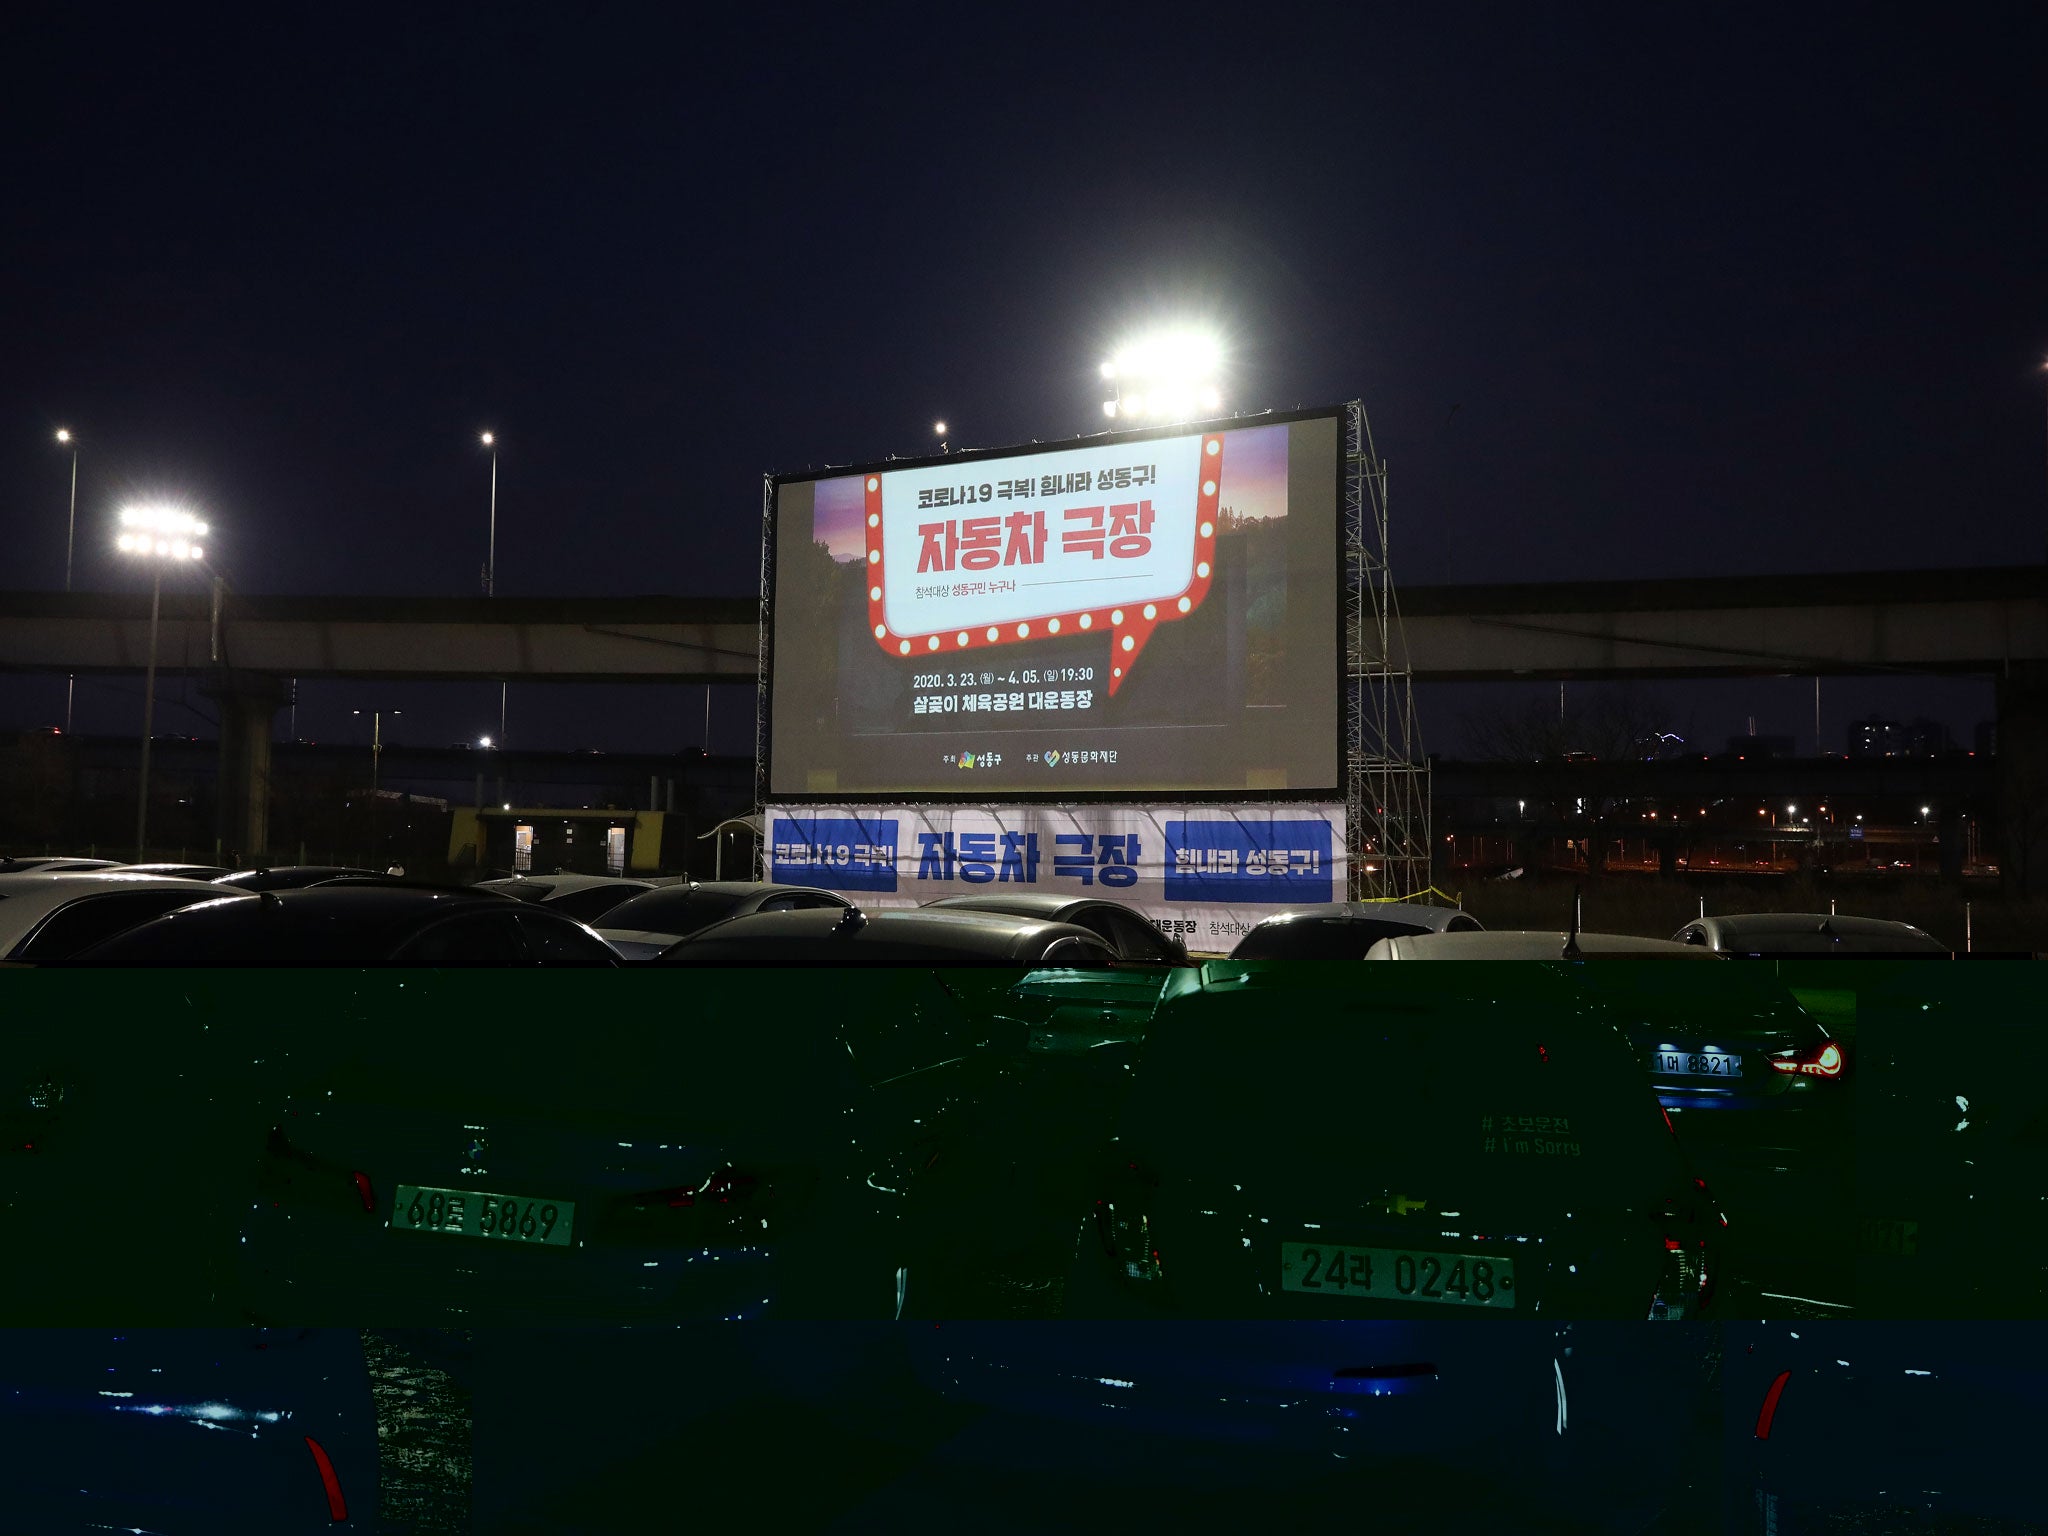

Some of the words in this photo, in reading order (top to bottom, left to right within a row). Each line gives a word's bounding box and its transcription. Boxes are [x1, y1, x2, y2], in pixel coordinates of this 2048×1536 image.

[918, 483, 992, 509] 코로나19
[997, 479, 1036, 501] 극복!
[1040, 471, 1092, 497] 힘내라
[1097, 465, 1156, 491] 성동구!
[917, 511, 1048, 573] 자동차
[1062, 500, 1156, 560] 극장
[915, 584, 950, 599] 참석대상
[952, 581, 986, 597] 성동구민
[988, 579, 1016, 594] 누구나
[913, 673, 945, 688] 2020.
[947, 673, 958, 687] 3.
[960, 672, 977, 686] 23.
[980, 672, 994, 685] (월)
[1008, 670, 1020, 684] 4.
[1022, 669, 1040, 684] 05.
[1043, 669, 1058, 682] (일)
[1061, 667, 1094, 682] 19:30
[913, 695, 958, 714] 살곶이
[961, 692, 1025, 712] 체육공원
[1027, 689, 1093, 710] 대운동장
[976, 751, 1002, 768] 성동구
[1062, 750, 1118, 764] 성동문화재단
[775, 843, 850, 865] 코로나19
[917, 831, 1040, 884] 자동차
[1054, 833, 1141, 887] 극장
[1175, 847, 1239, 875] 힘내라
[1245, 849, 1320, 876] 성동구!
[1209, 921, 1251, 936] 참석대상
[1687, 1055, 1731, 1075] 8821
[1534, 1138, 1582, 1156] Sorry
[407, 1191, 466, 1231] 68로
[480, 1197, 559, 1240] 5869
[1301, 1248, 1373, 1290] 24라
[1395, 1254, 1495, 1303] 0248
